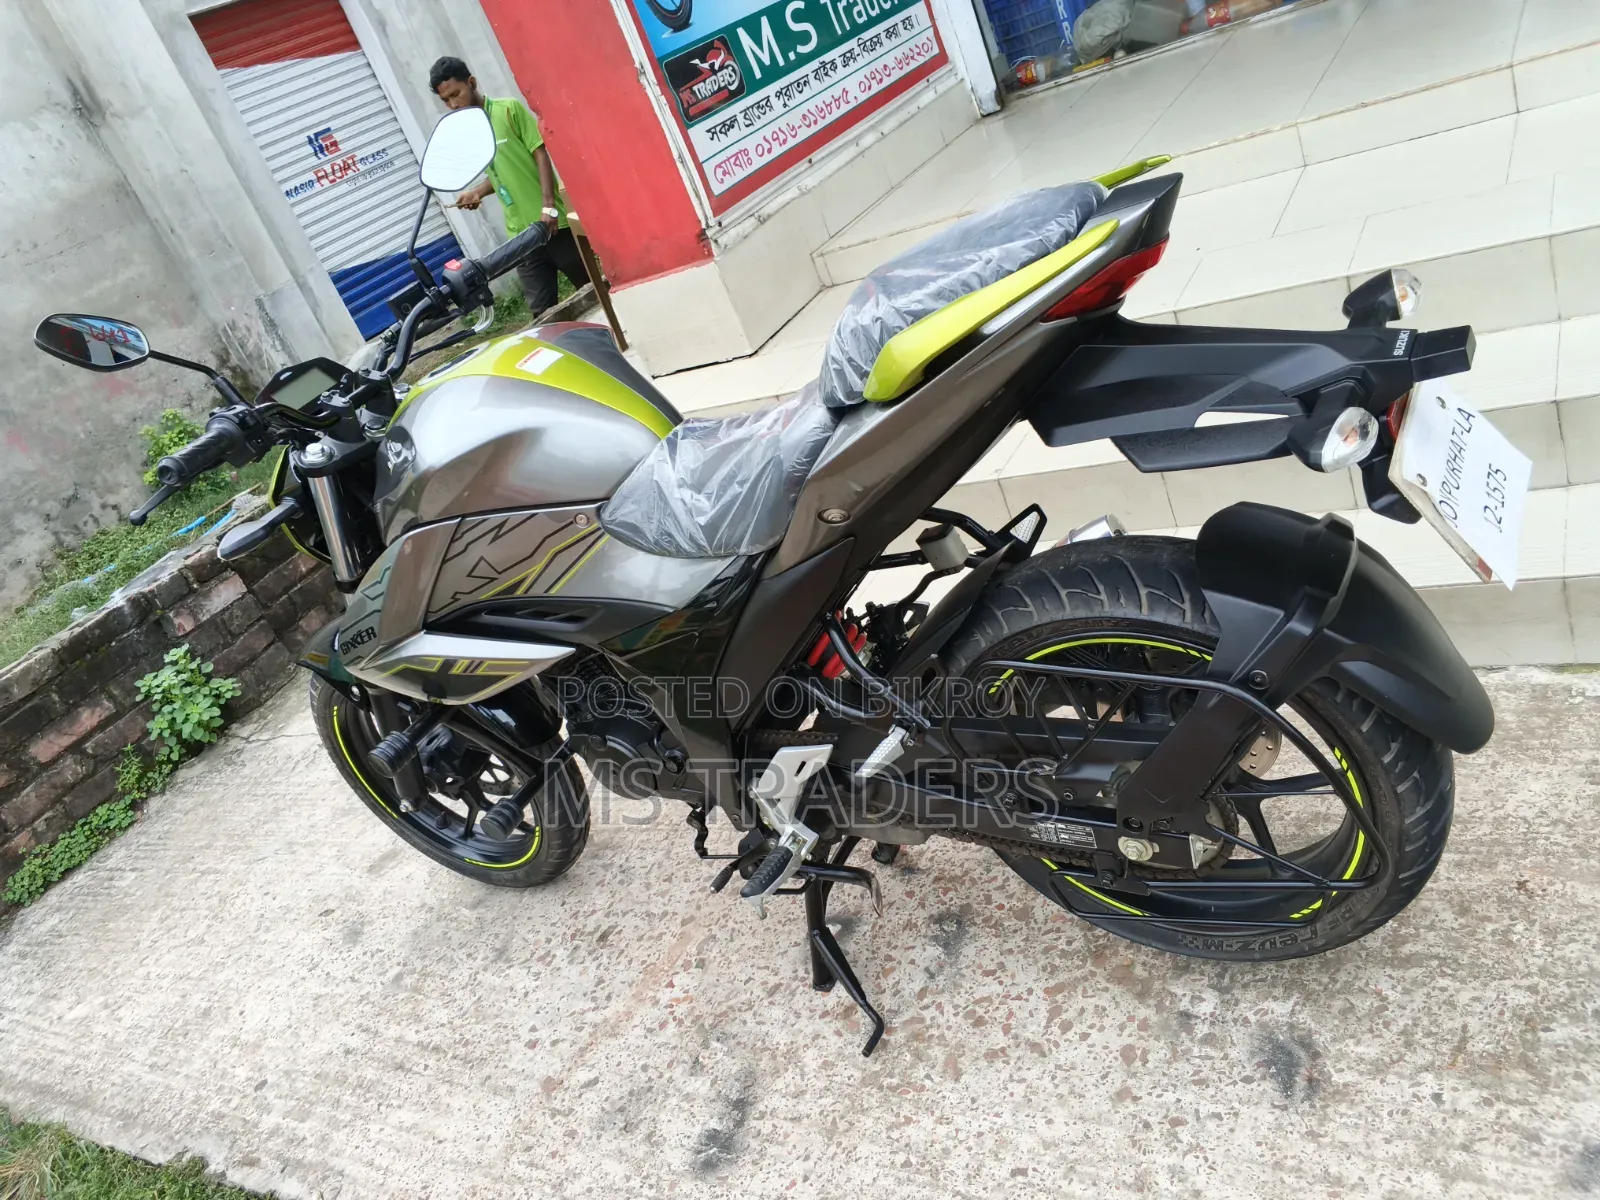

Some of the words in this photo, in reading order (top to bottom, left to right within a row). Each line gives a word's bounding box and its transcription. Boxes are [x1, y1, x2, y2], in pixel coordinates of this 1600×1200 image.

[692, 66, 737, 100] TRADERS
[705, 114, 742, 142] সকল
[774, 72, 813, 109] পুরাতন
[811, 58, 838, 85] বাইক
[883, 22, 903, 44] করা
[313, 153, 362, 187] FLOAT
[359, 148, 390, 167] GLASS
[1393, 330, 1411, 356] SUZUKI
[1482, 463, 1508, 533] 12-1575
